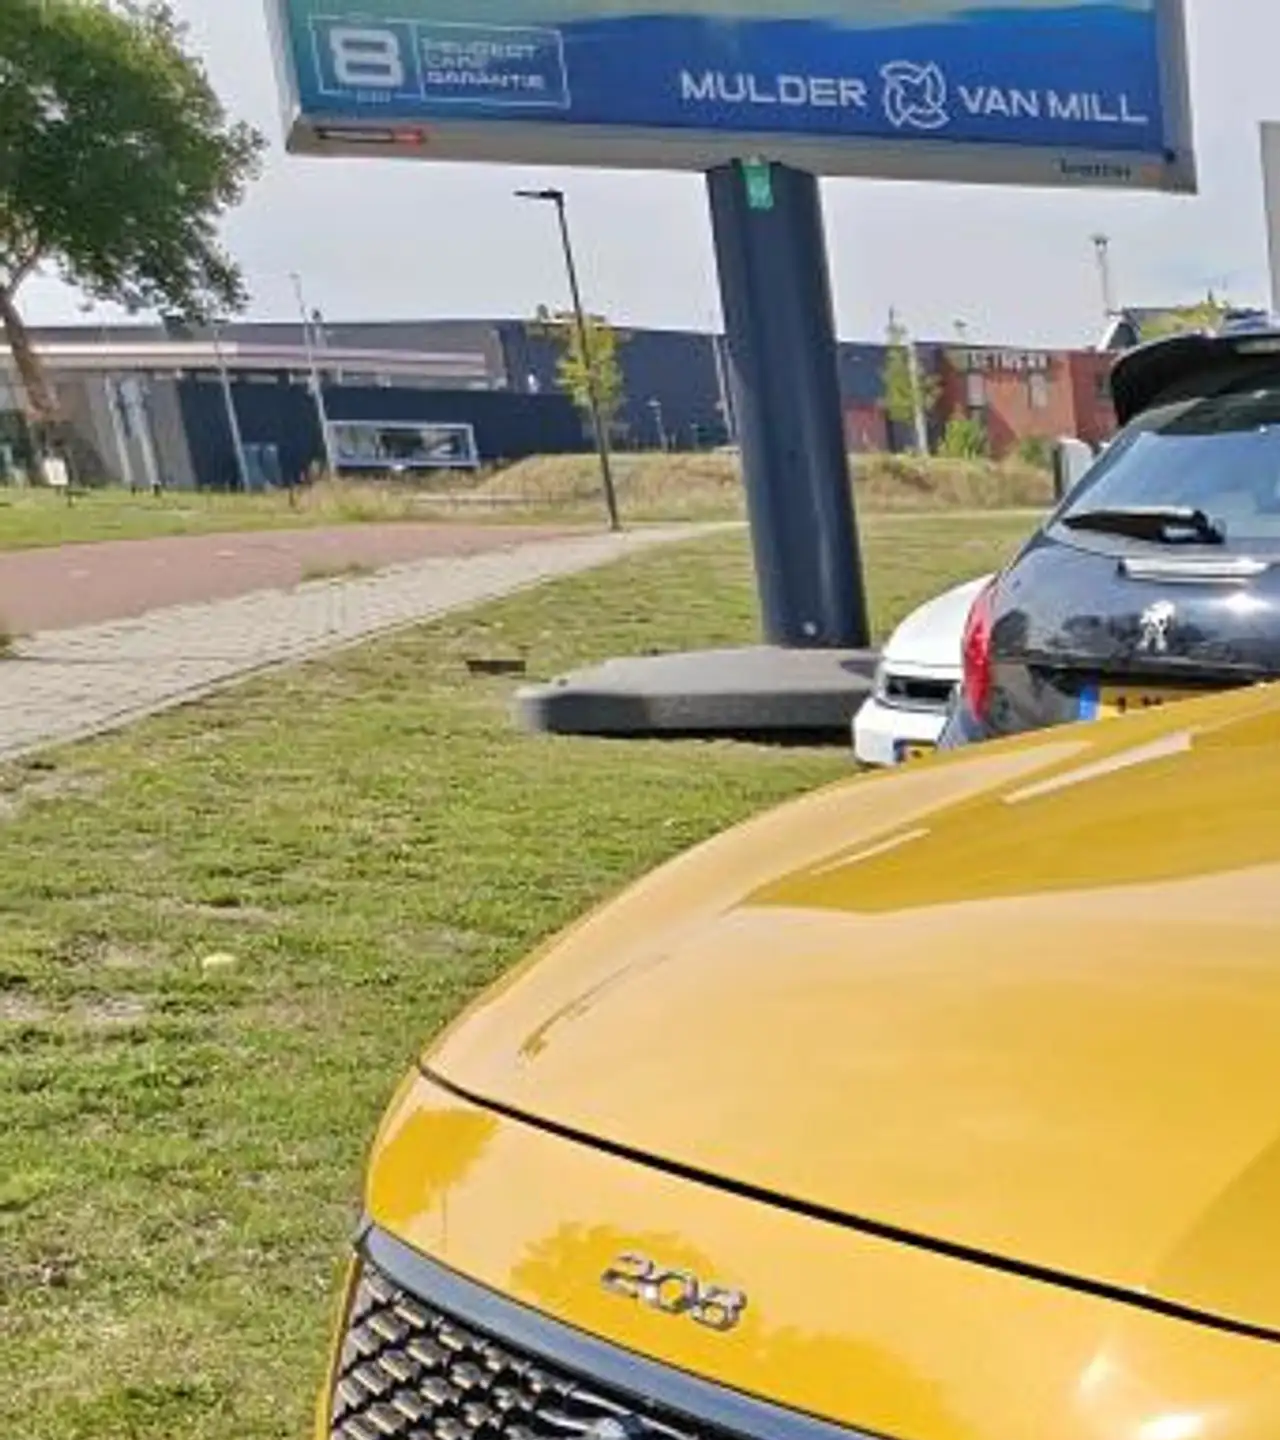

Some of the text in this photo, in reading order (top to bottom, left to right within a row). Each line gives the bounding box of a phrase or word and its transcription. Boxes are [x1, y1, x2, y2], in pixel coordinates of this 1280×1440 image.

[681, 69, 1149, 124] MULDER VAN MILL
[600, 1251, 747, 1332] 208
